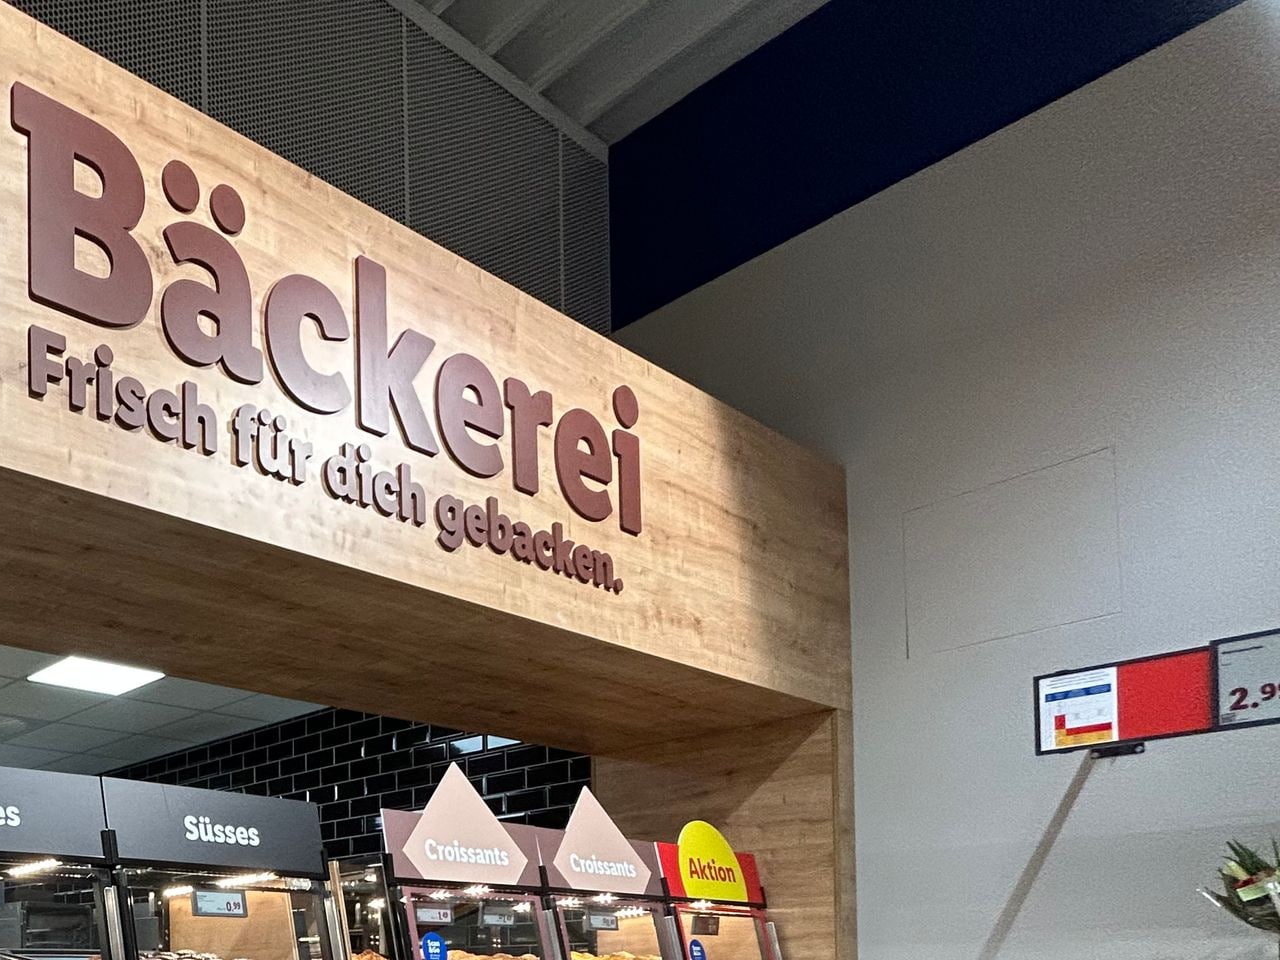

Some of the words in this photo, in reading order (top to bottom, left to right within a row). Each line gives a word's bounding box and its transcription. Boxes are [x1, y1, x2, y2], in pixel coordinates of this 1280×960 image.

[10, 81, 642, 536] Bäckerei
[27, 324, 218, 456] Frisch
[230, 403, 313, 486] für
[320, 441, 426, 527] dich
[434, 493, 624, 595] gebacken.
[183, 815, 260, 847] Süsses
[424, 838, 510, 866] Croissants
[569, 853, 638, 878] Croissants
[688, 857, 737, 883] Aktion
